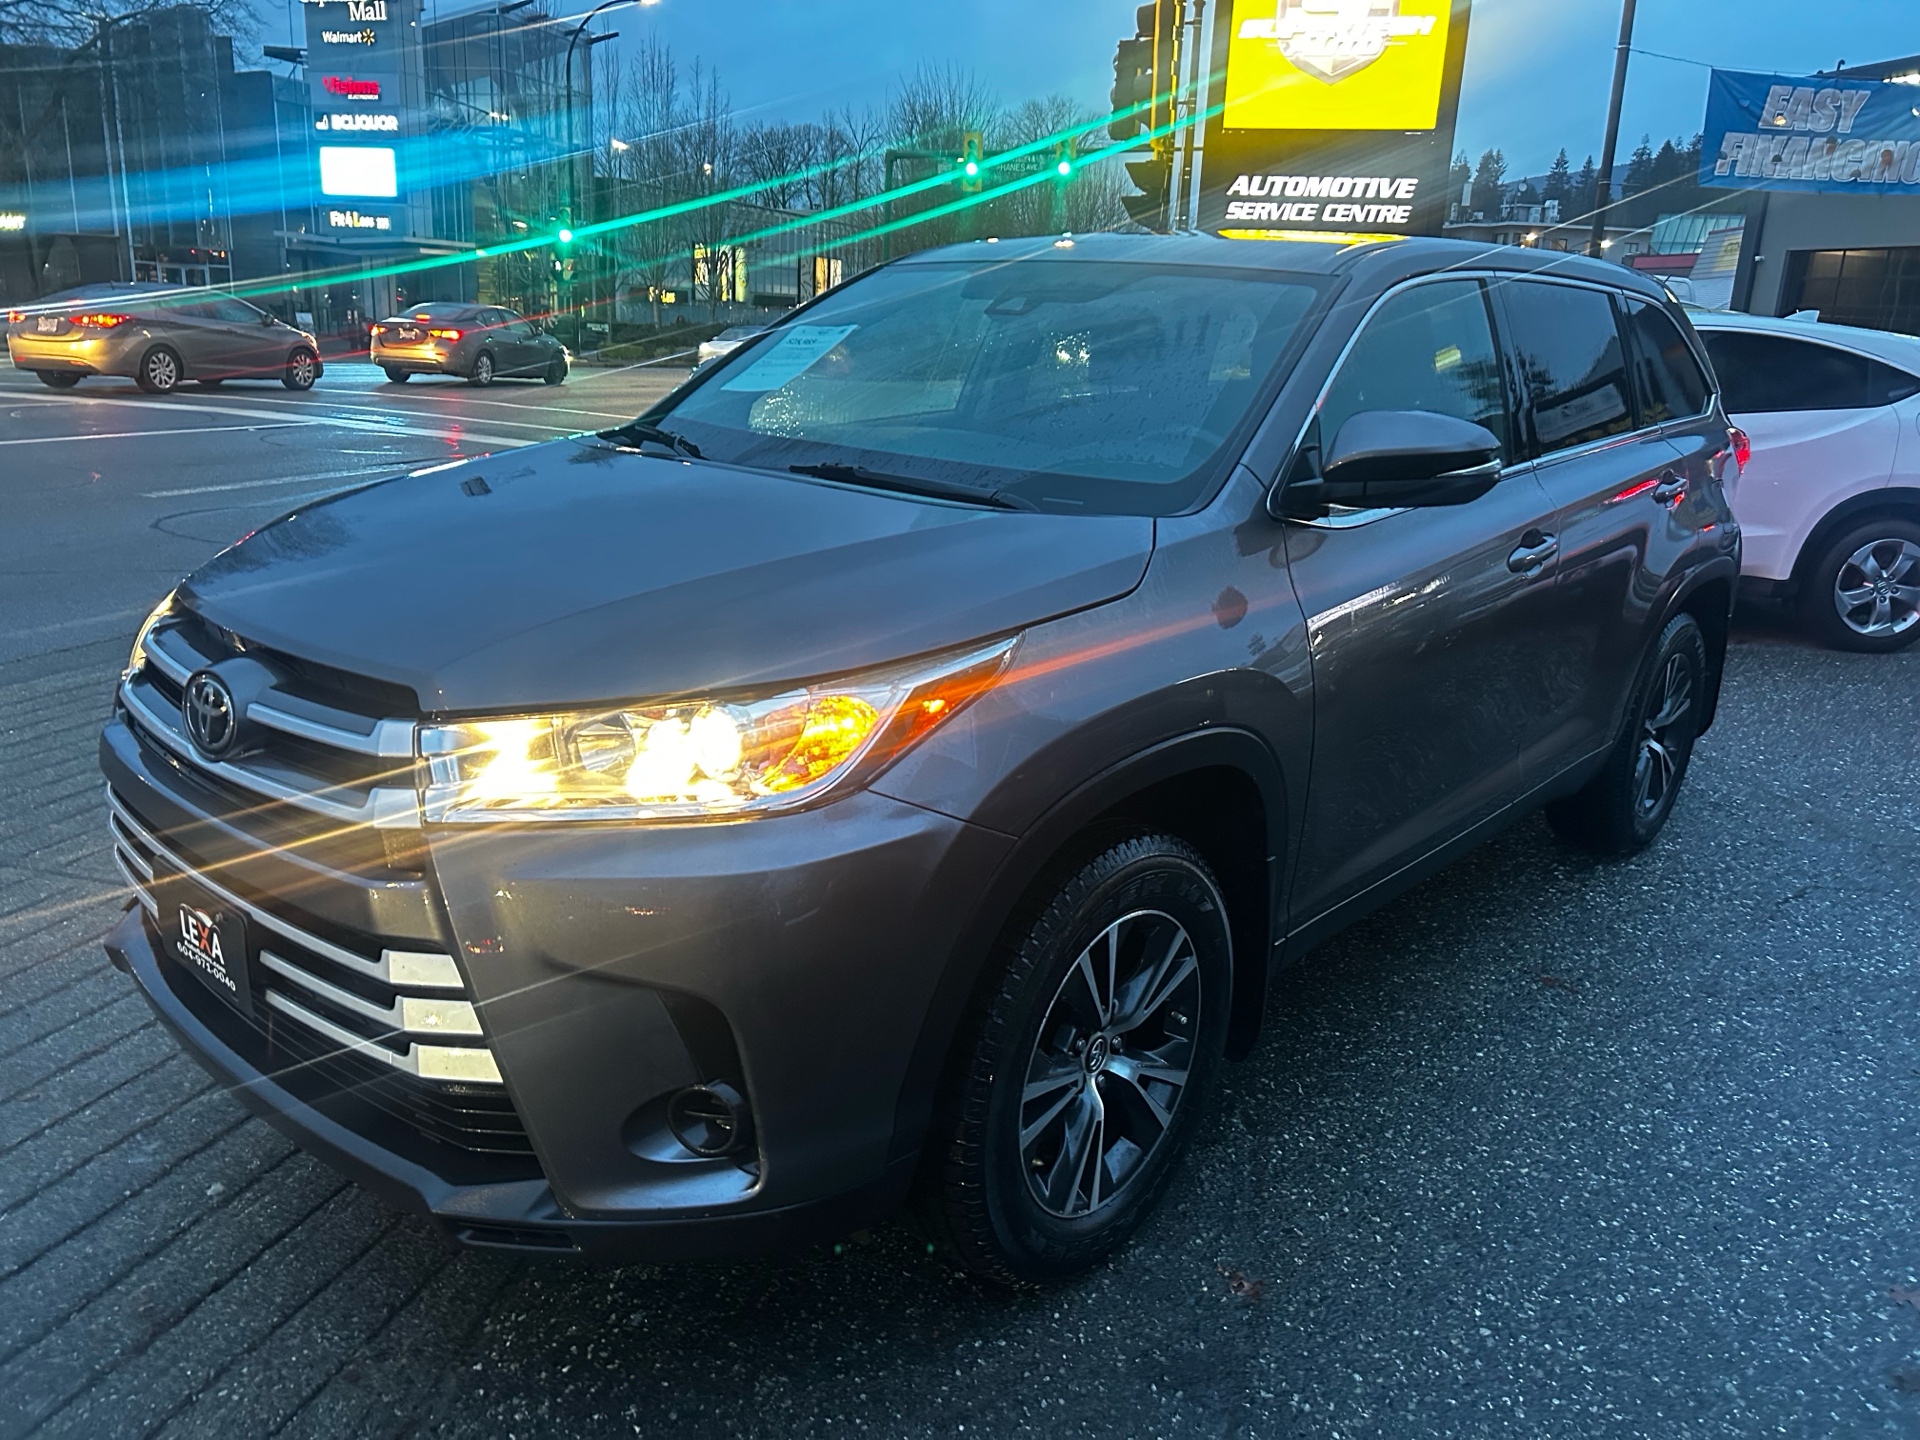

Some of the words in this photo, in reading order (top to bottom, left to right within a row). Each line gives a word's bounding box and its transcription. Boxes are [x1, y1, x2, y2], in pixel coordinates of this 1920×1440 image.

[348, 1, 387, 21] Mall
[322, 31, 362, 43] Walmart
[323, 77, 380, 95] Visions
[1758, 85, 1870, 133] EASY
[1226, 175, 1418, 199] AUTOMOTIVE
[1225, 202, 1319, 221] SERVICE
[1321, 204, 1412, 223] CENTRE
[180, 909, 224, 965] LEXA
